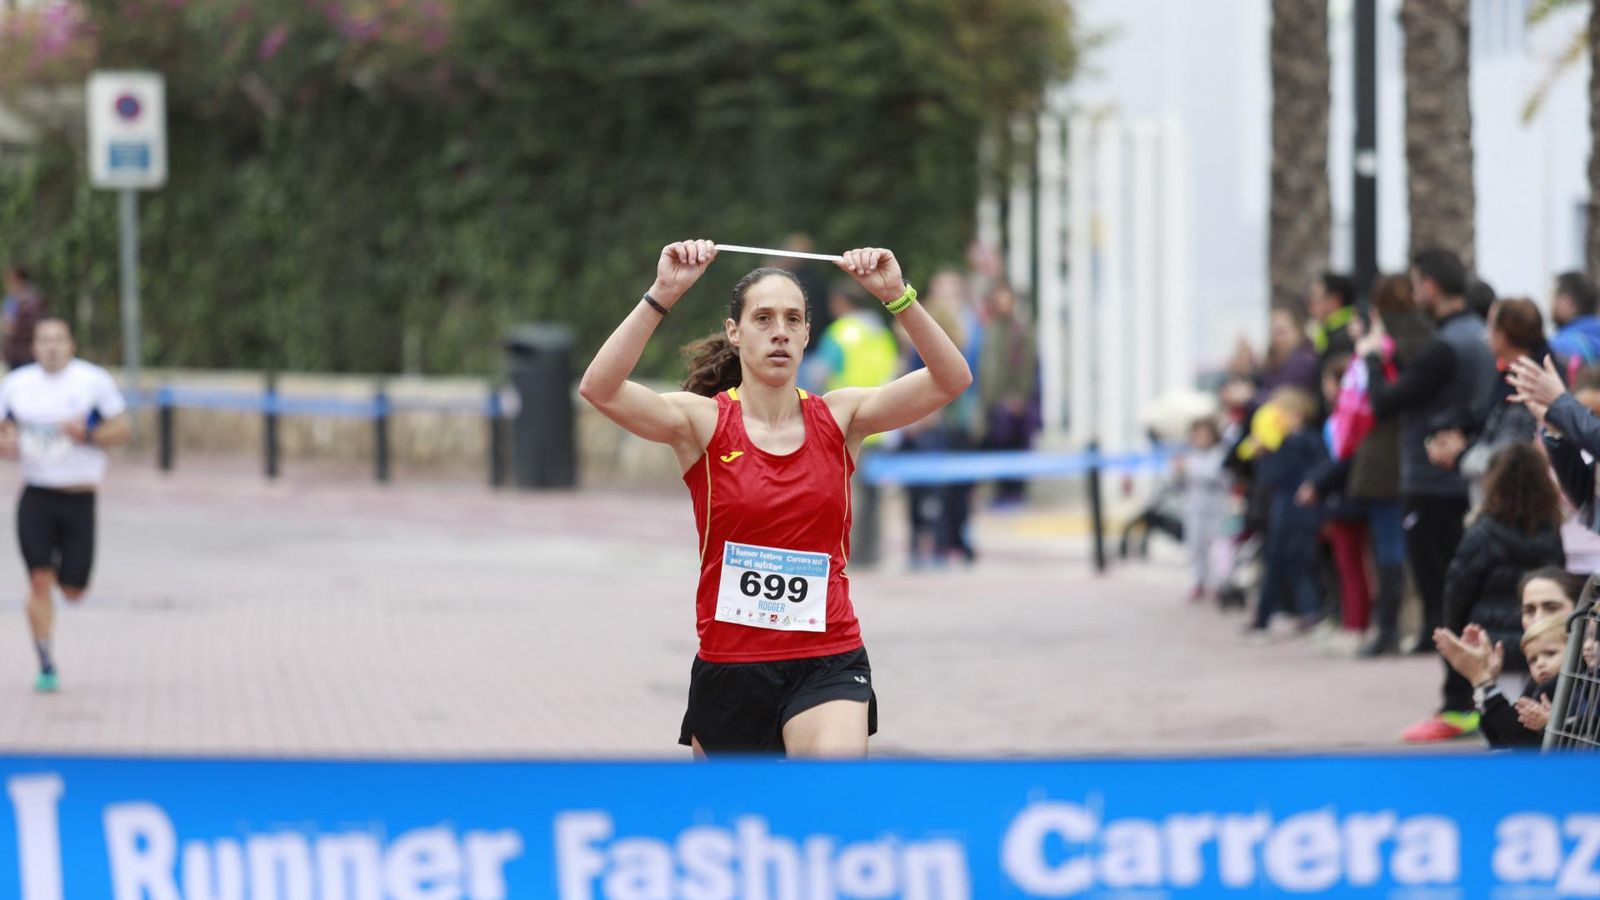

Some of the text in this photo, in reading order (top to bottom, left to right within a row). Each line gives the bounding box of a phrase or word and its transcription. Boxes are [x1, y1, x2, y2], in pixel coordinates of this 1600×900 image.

[740, 570, 808, 603] 699
[758, 600, 786, 613] ROGGER
[103, 802, 523, 900] Runner
[553, 809, 971, 900] Fashion
[1002, 801, 1460, 897] Carrera
